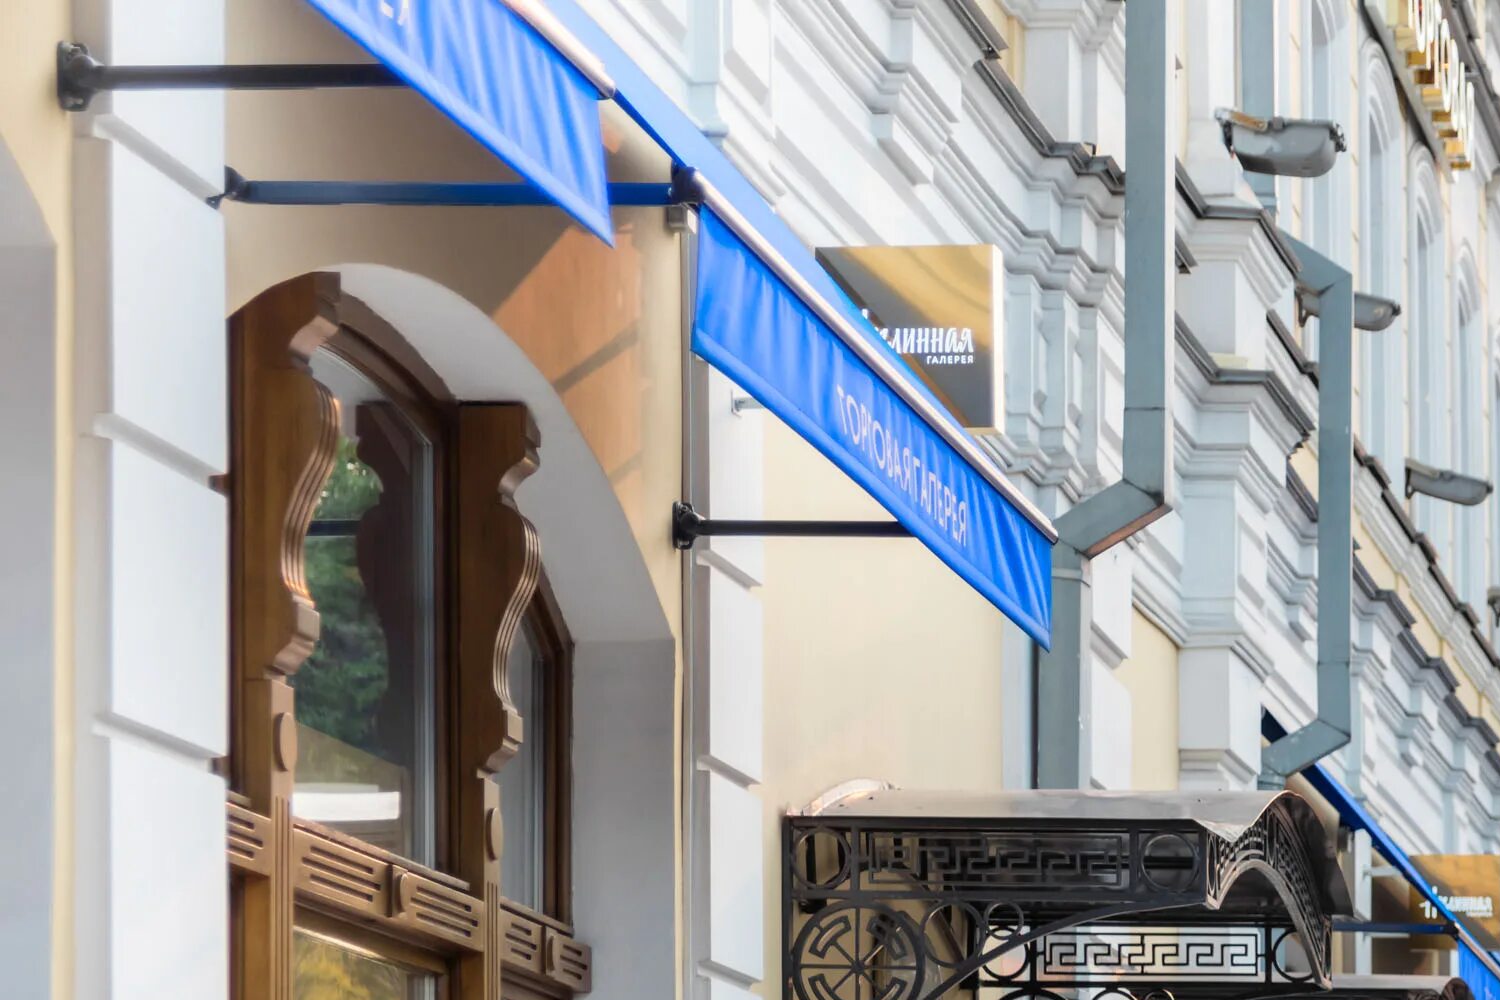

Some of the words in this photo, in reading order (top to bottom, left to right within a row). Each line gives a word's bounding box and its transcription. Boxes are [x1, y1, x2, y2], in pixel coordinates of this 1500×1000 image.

[926, 355, 974, 365] ГАЛЕРЕЯ
[837, 384, 912, 495] ТОРГОВАЯ
[913, 456, 967, 547] ГАЛЕРЕЯ
